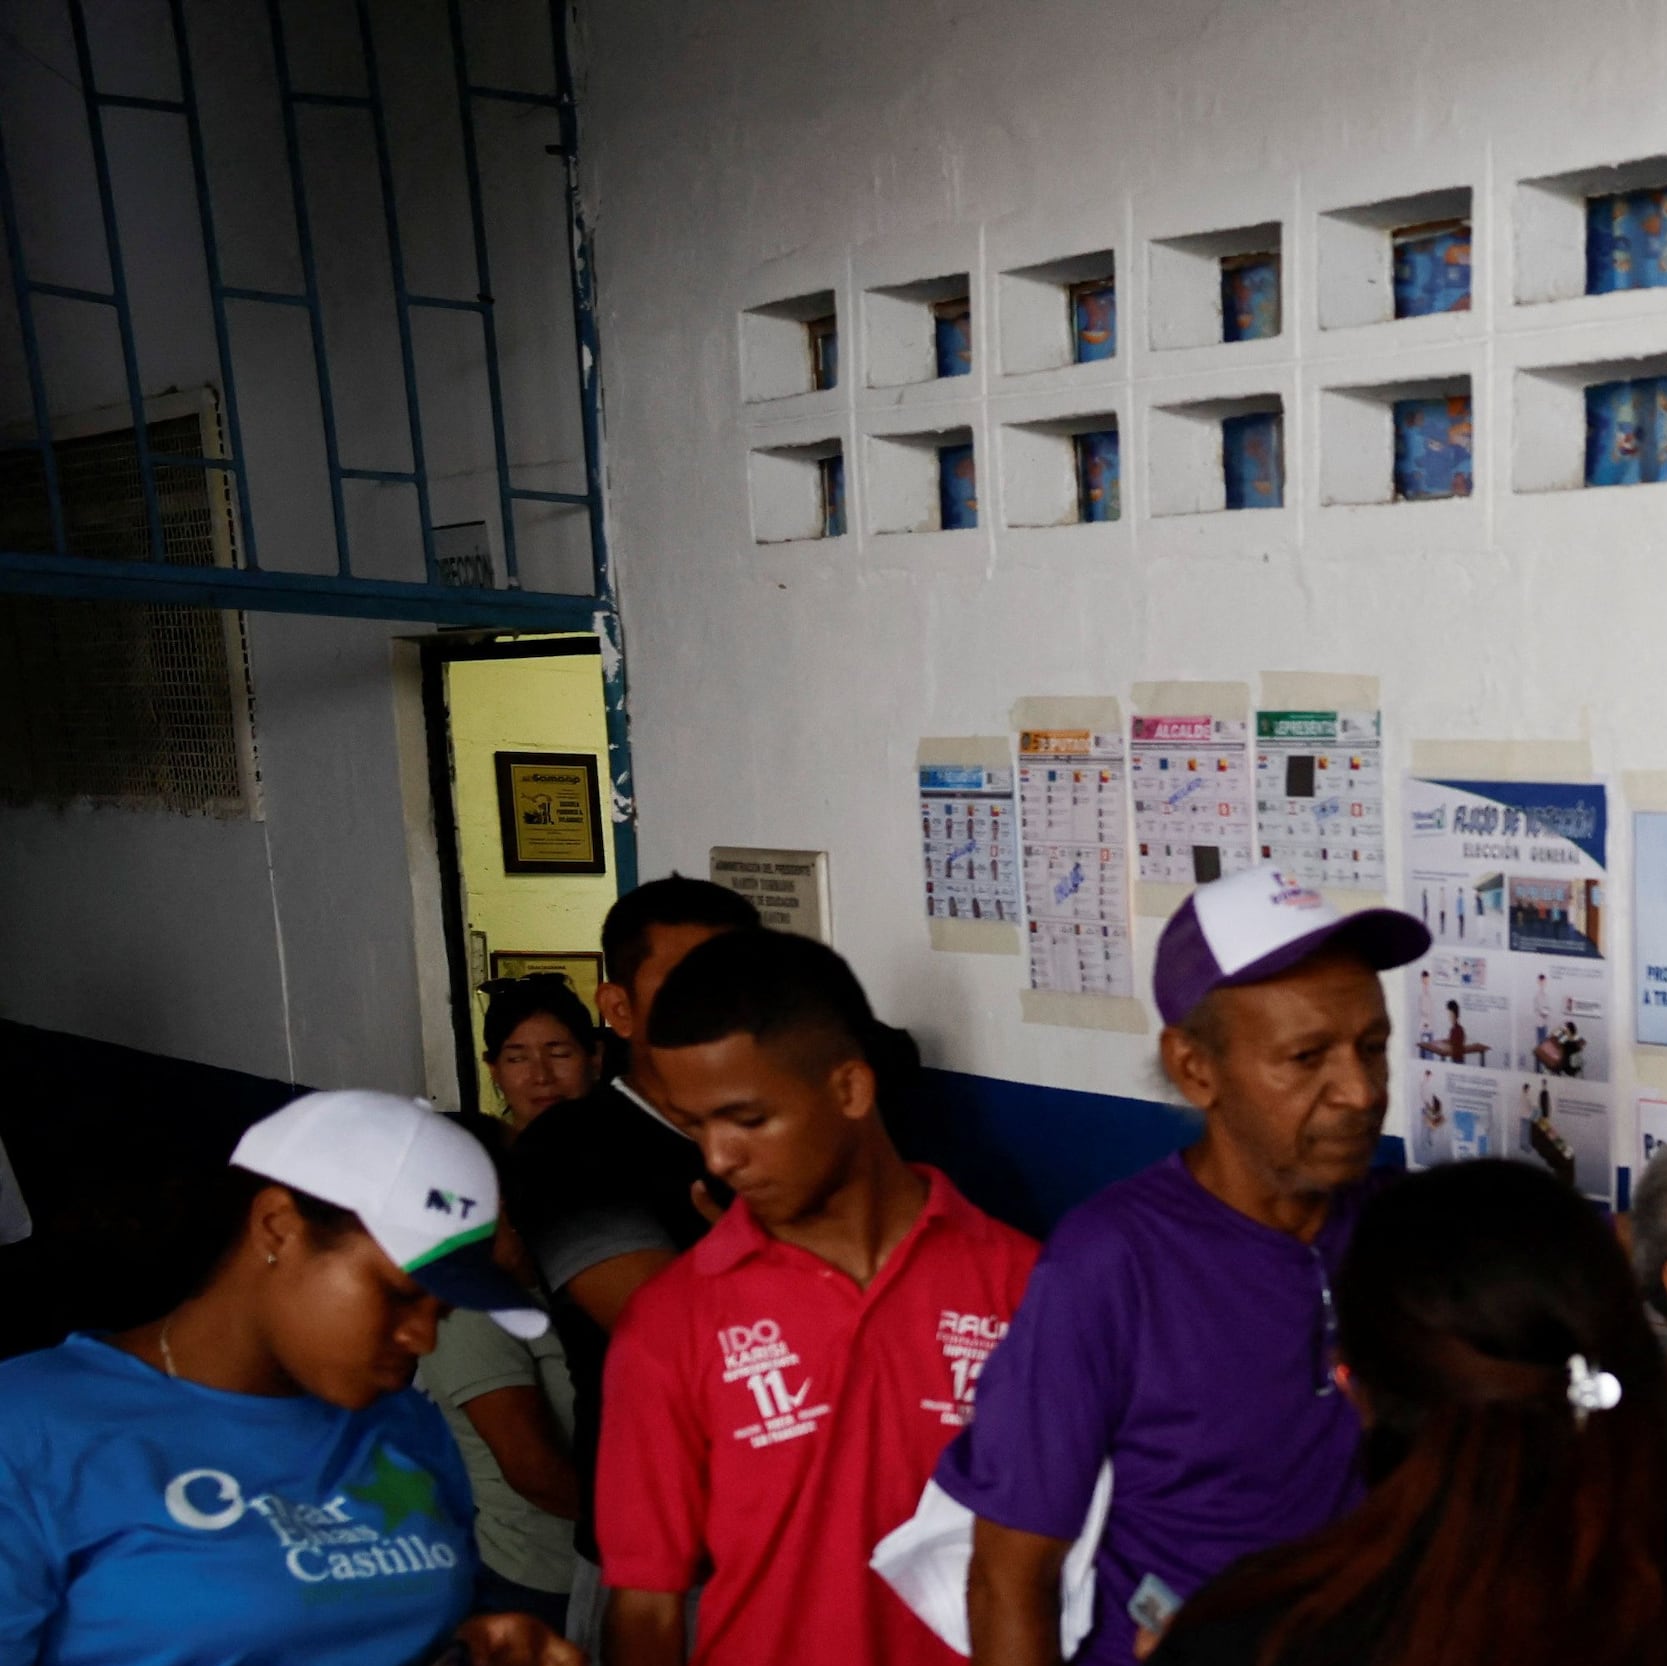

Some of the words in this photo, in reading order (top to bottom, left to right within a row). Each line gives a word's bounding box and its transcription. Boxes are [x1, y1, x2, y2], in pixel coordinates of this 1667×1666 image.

[1643, 990, 1650, 1006] A
[747, 1369, 791, 1419] 11
[286, 1534, 457, 1582] Castillo
